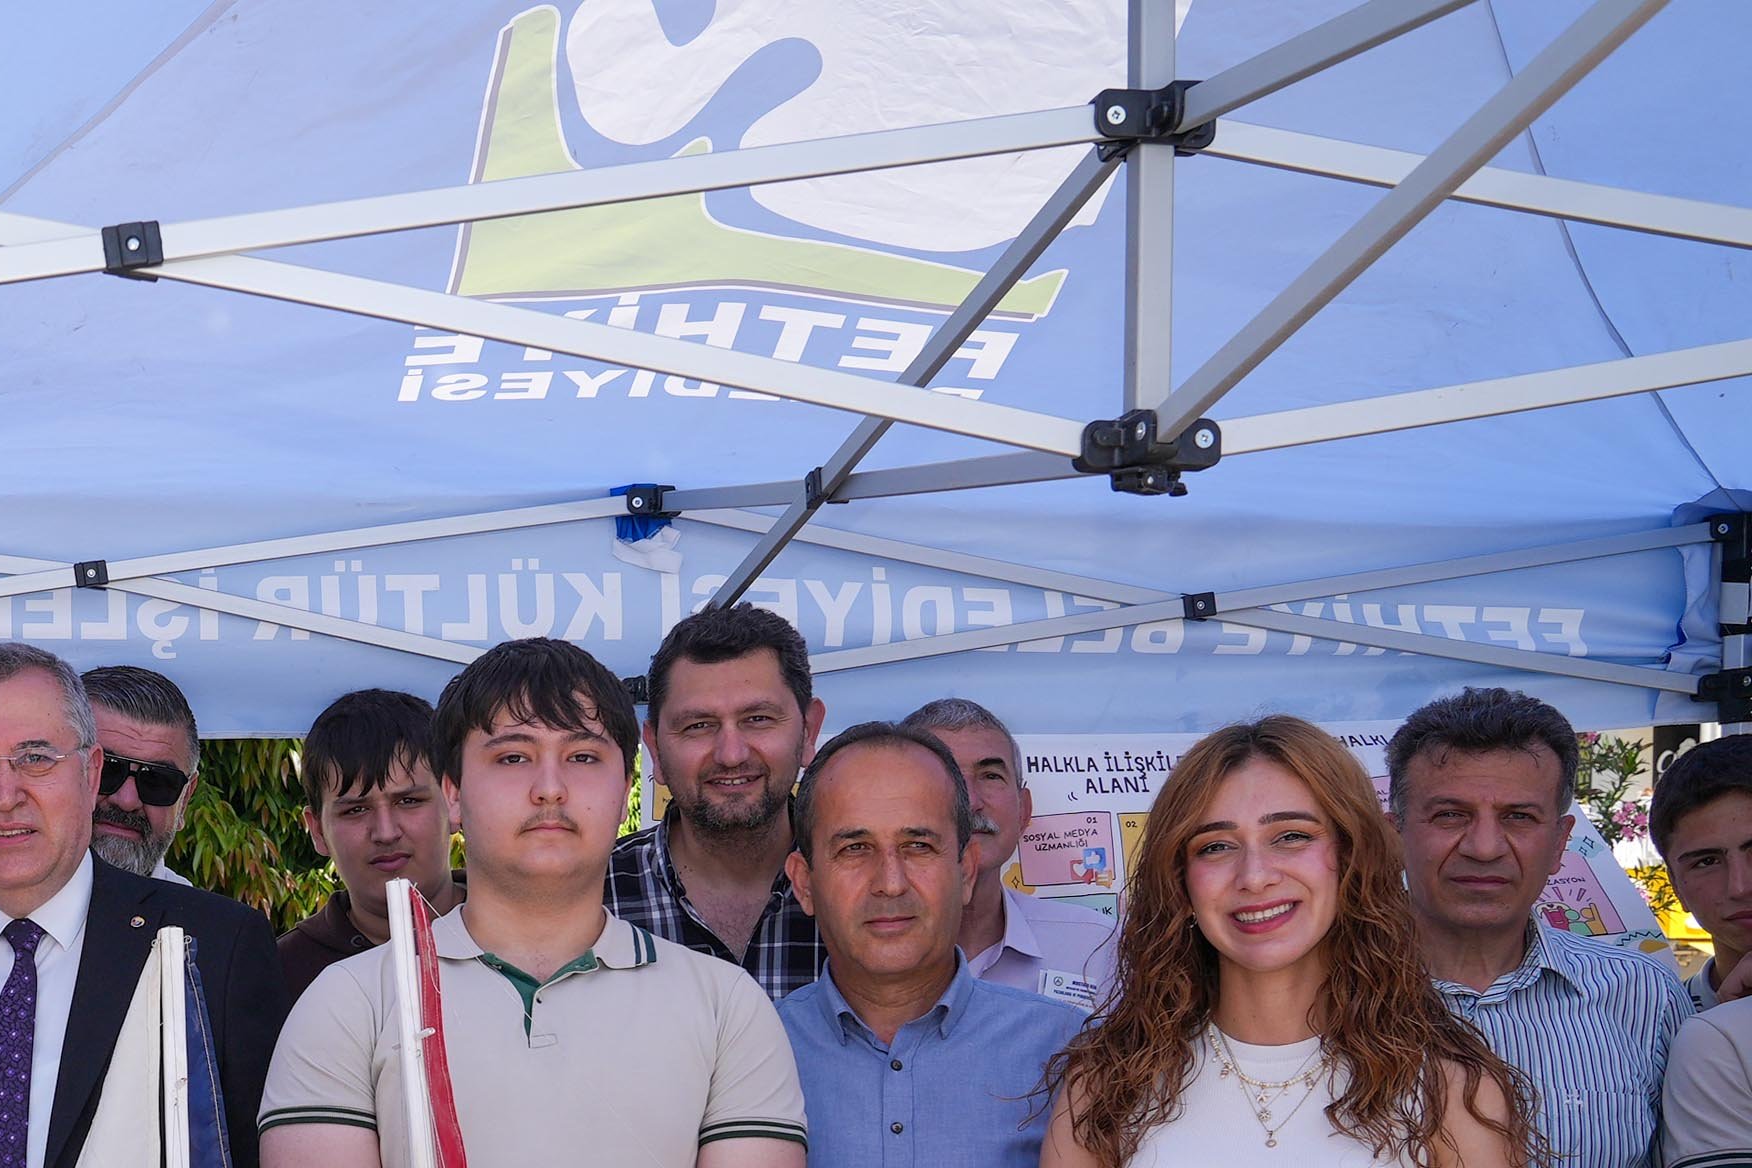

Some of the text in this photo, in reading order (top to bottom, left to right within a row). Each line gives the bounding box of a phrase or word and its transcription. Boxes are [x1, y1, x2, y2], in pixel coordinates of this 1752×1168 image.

[1026, 756, 1100, 773] HALKLA
[1023, 828, 1098, 843] SOSYAL MEDYA
[1034, 839, 1088, 852] UZMANLIĞI
